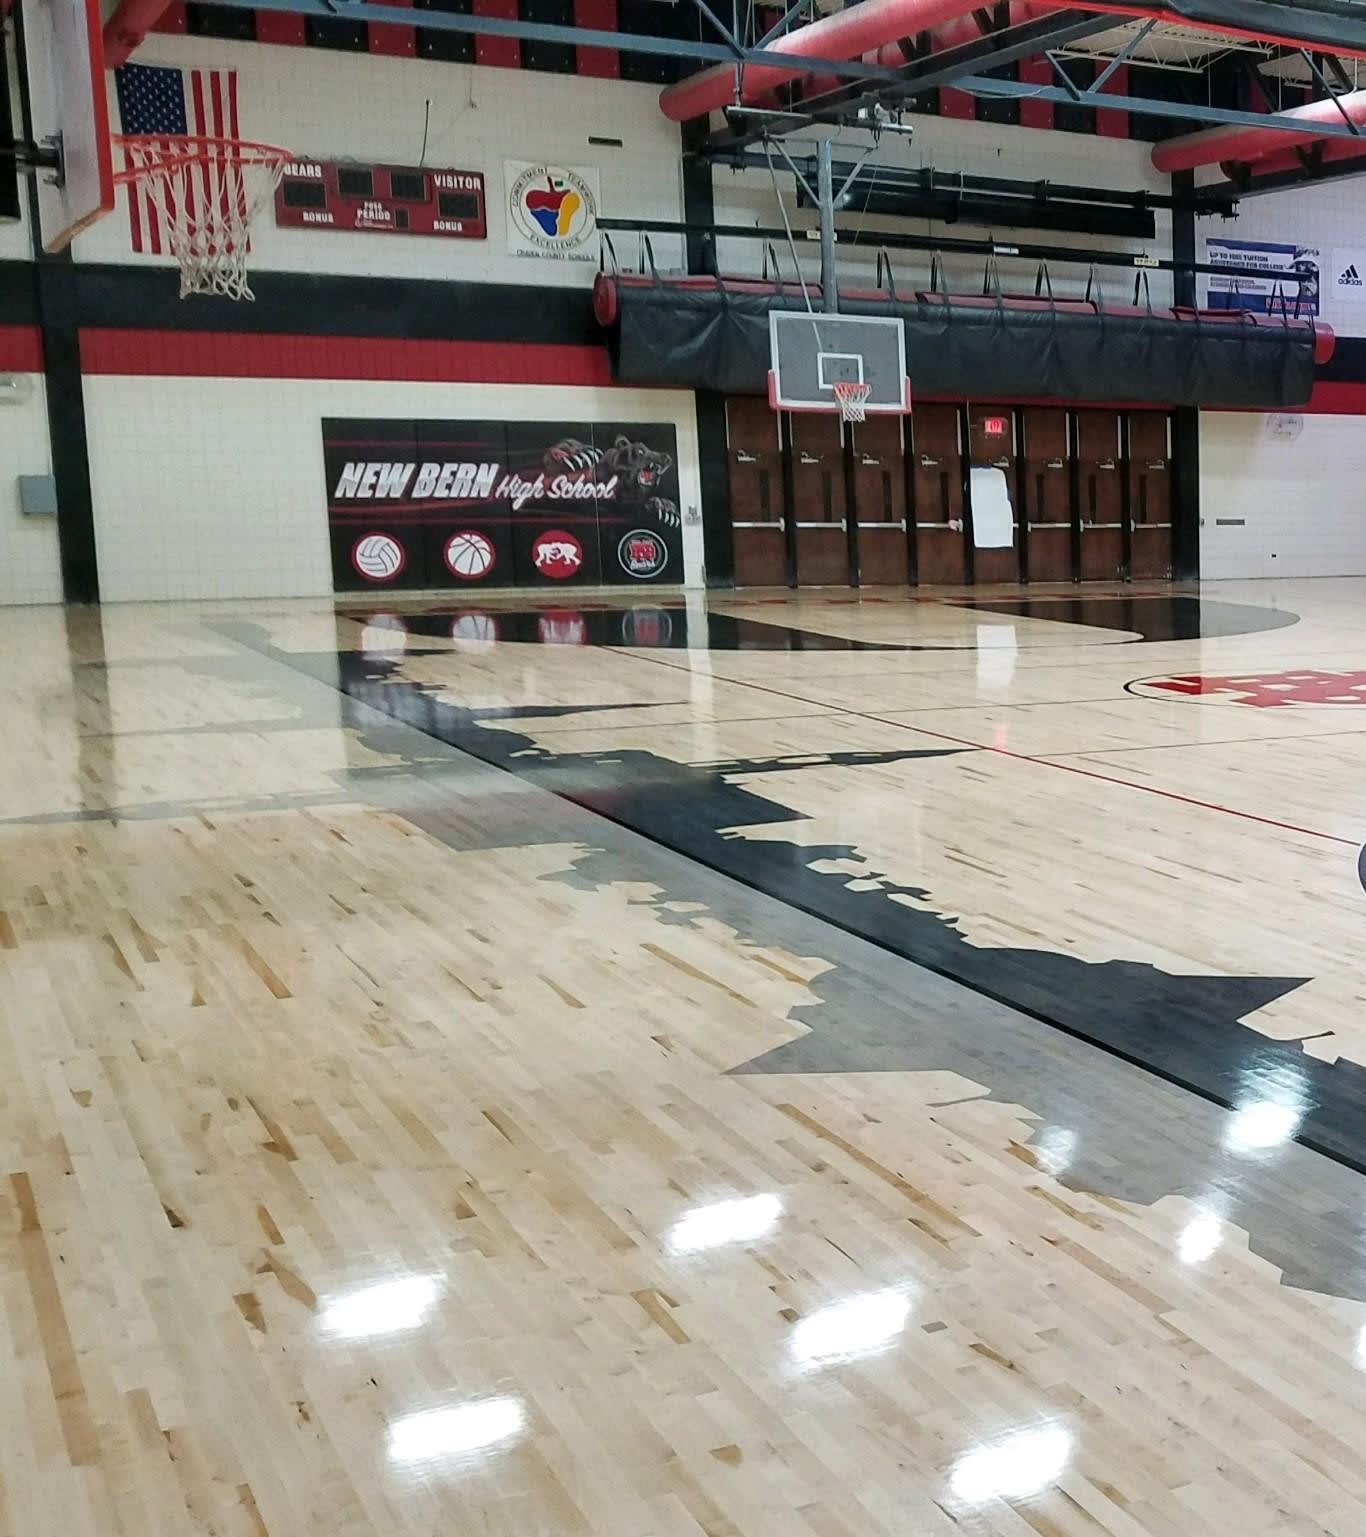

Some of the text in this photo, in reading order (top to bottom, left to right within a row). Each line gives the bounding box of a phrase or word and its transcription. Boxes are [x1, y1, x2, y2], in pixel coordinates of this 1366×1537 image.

[434, 174, 482, 190] VISITOR
[303, 212, 334, 223] BONUS
[357, 208, 391, 221] PERIOD
[433, 221, 463, 232] BONUS
[1338, 278, 1363, 287] adidas
[334, 462, 618, 511] NEW BERN High School
